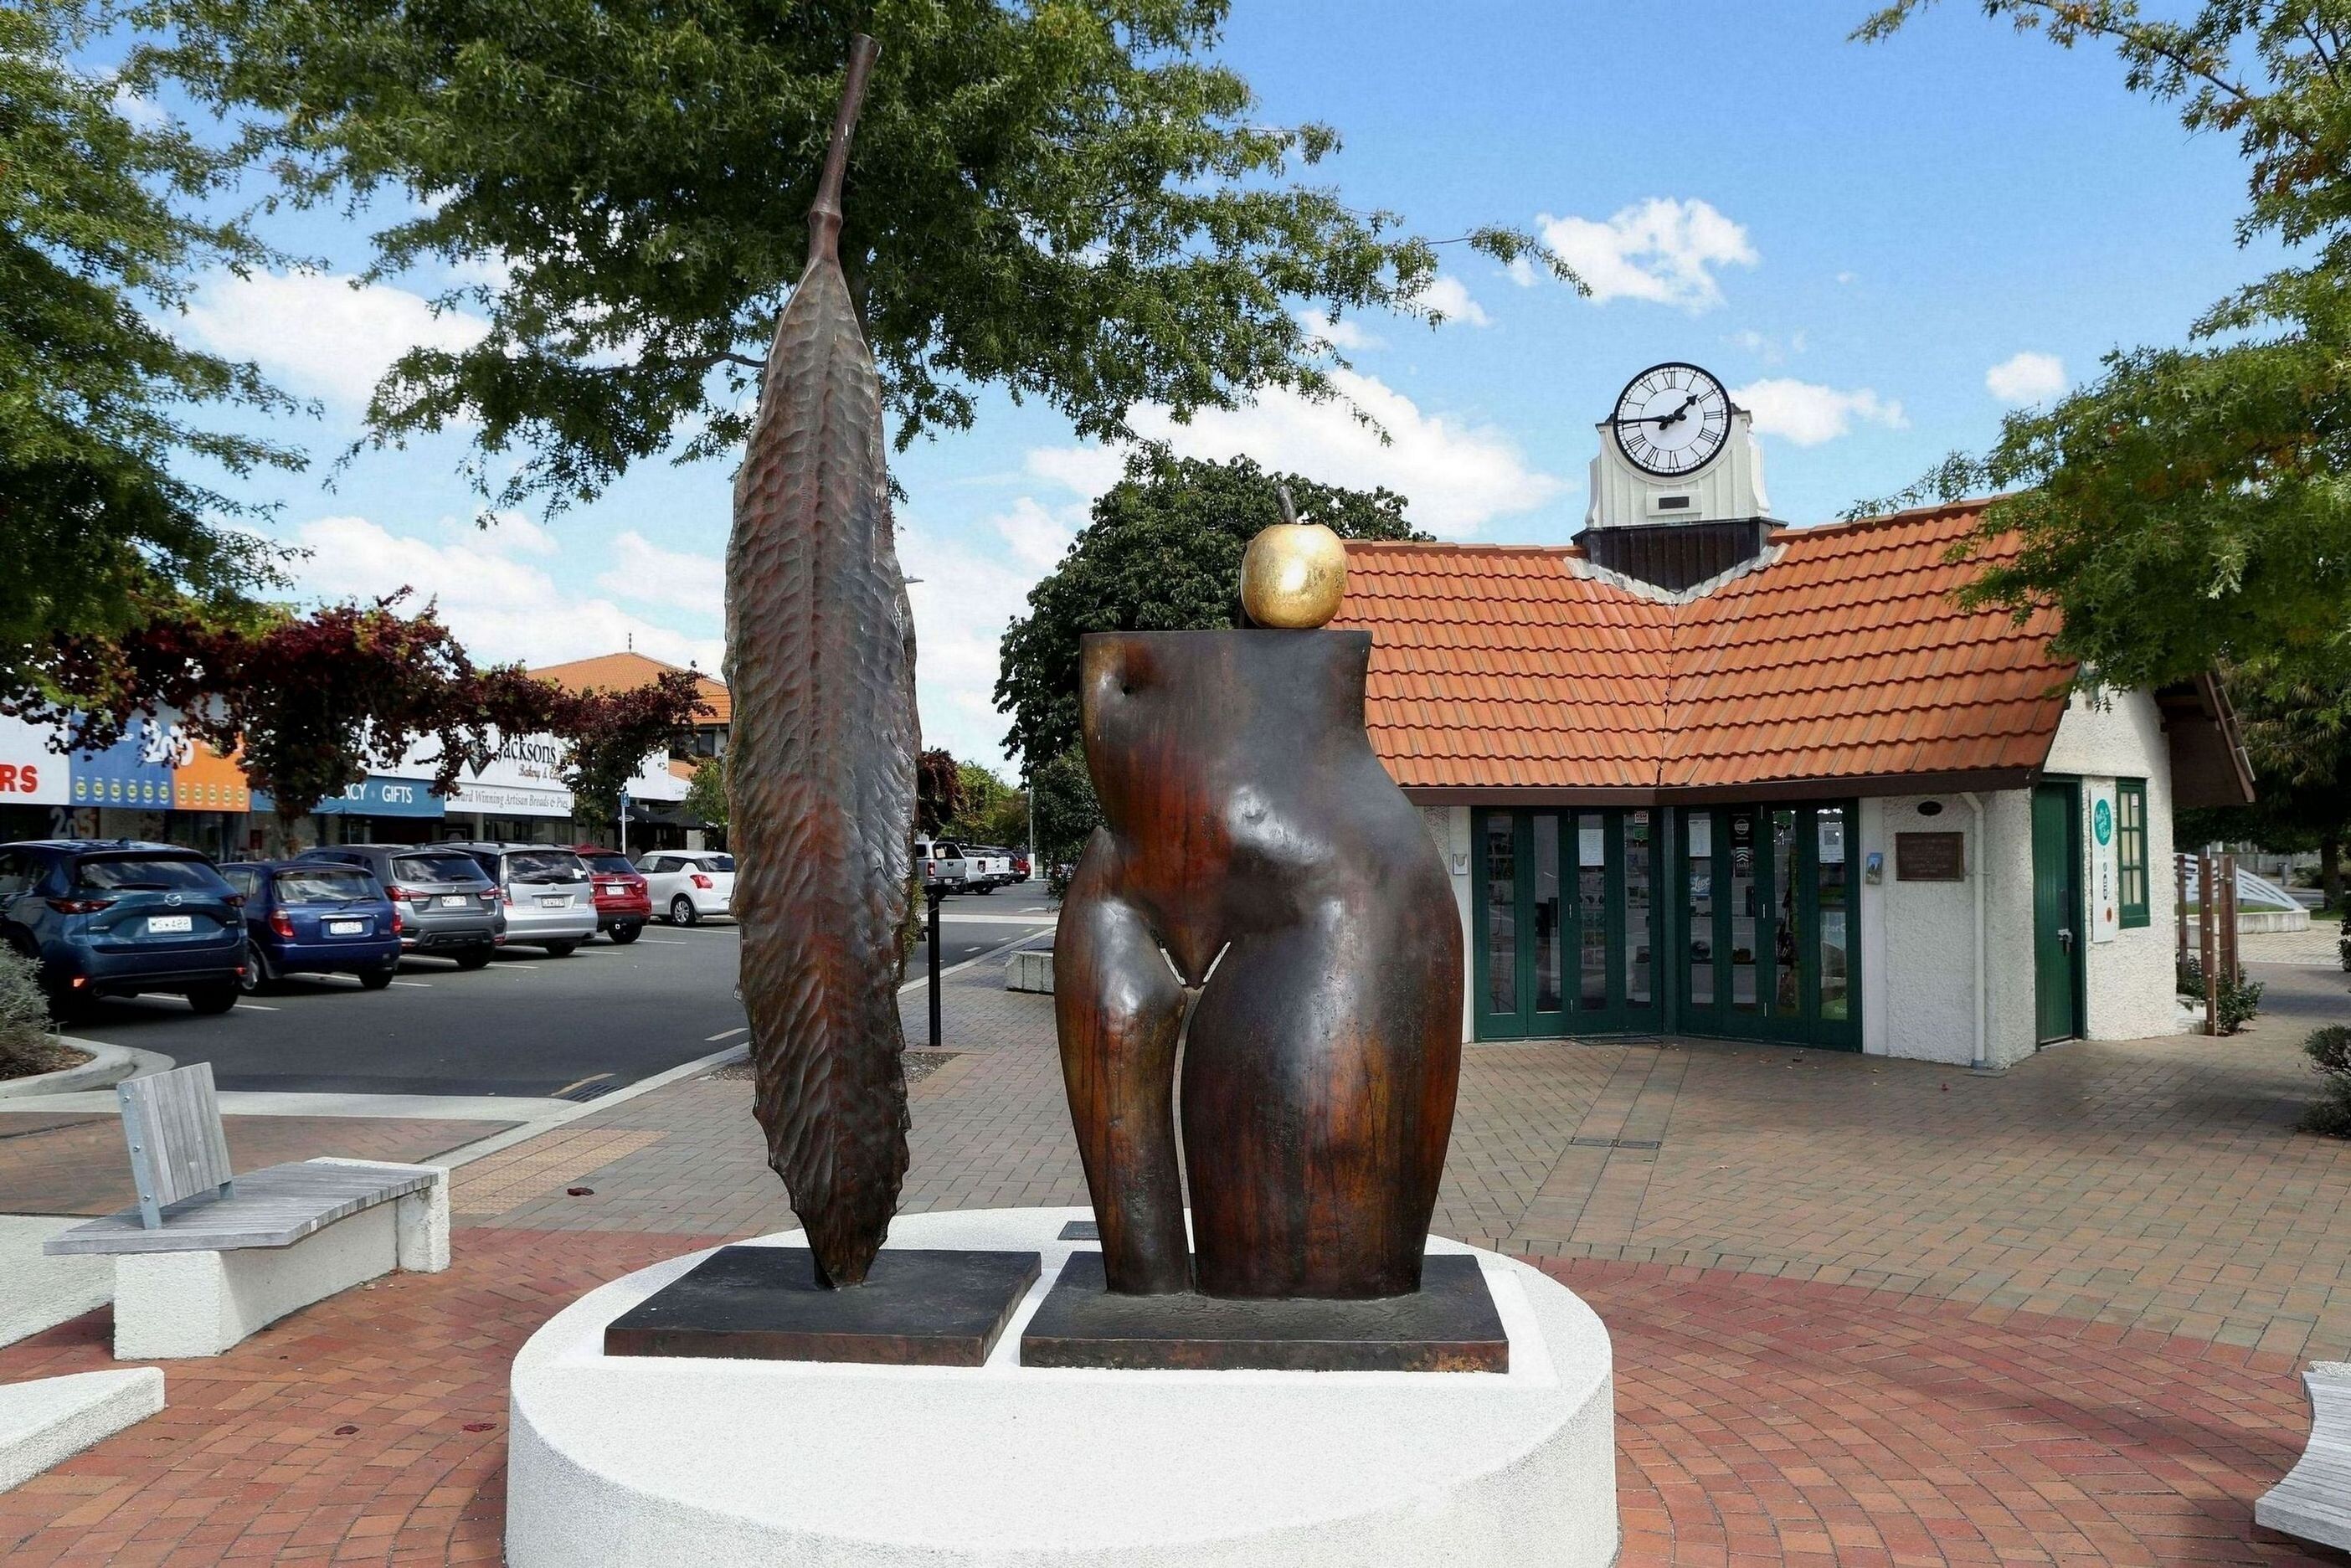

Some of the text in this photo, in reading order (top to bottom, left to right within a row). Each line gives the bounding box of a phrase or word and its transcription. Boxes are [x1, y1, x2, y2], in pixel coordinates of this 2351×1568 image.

[497, 730, 556, 764] Jacksons
[382, 784, 413, 804] GIFTS
[475, 790, 504, 809] Winning
[504, 793, 528, 805] Artisan
[529, 794, 549, 807] Breads
